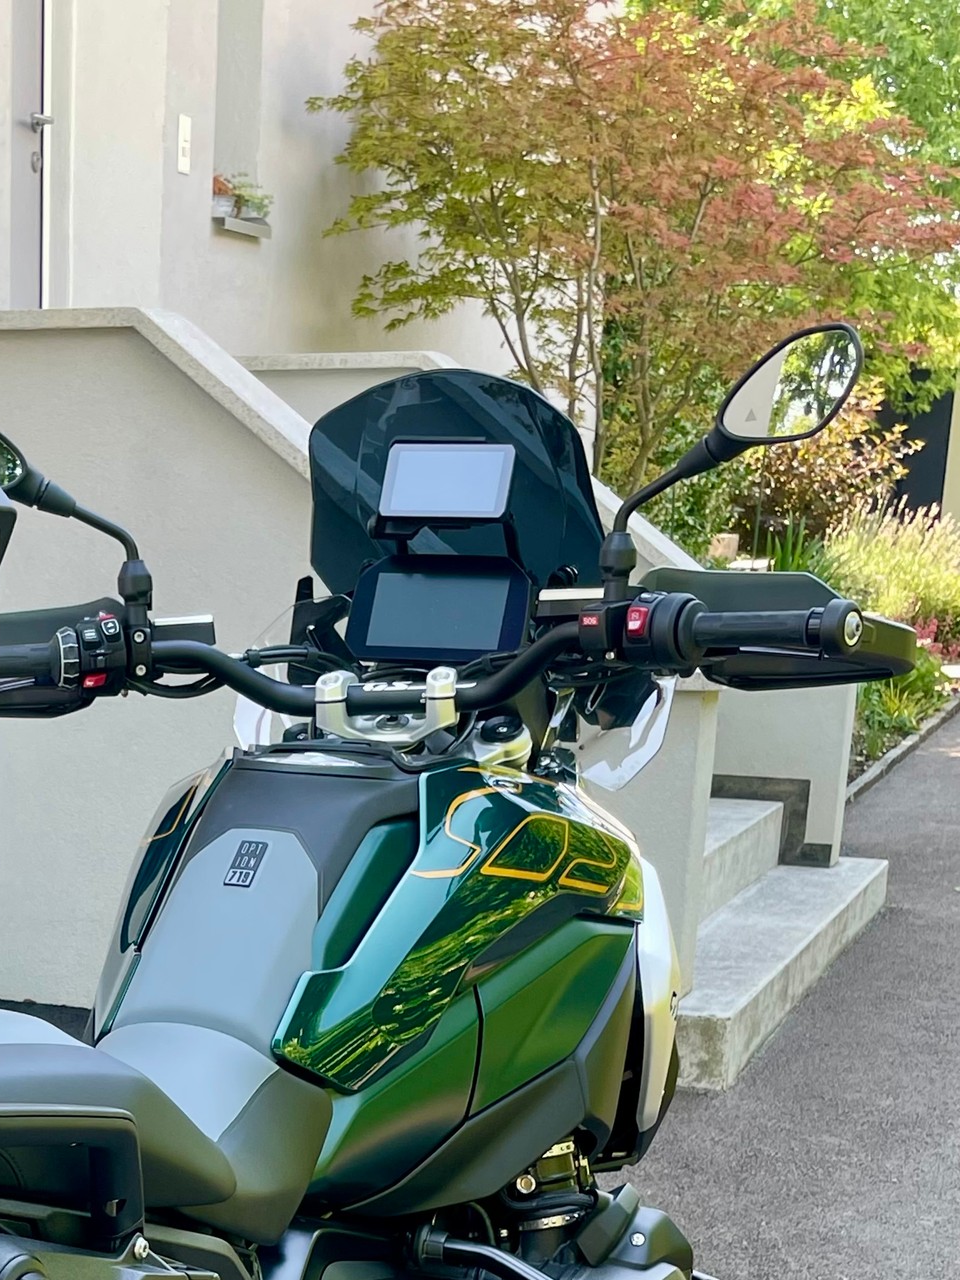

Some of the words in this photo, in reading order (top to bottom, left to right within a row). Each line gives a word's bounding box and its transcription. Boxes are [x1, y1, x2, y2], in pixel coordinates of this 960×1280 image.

[582, 616, 598, 626] SOS
[241, 842, 263, 855] OPT
[228, 870, 251, 883] 719
